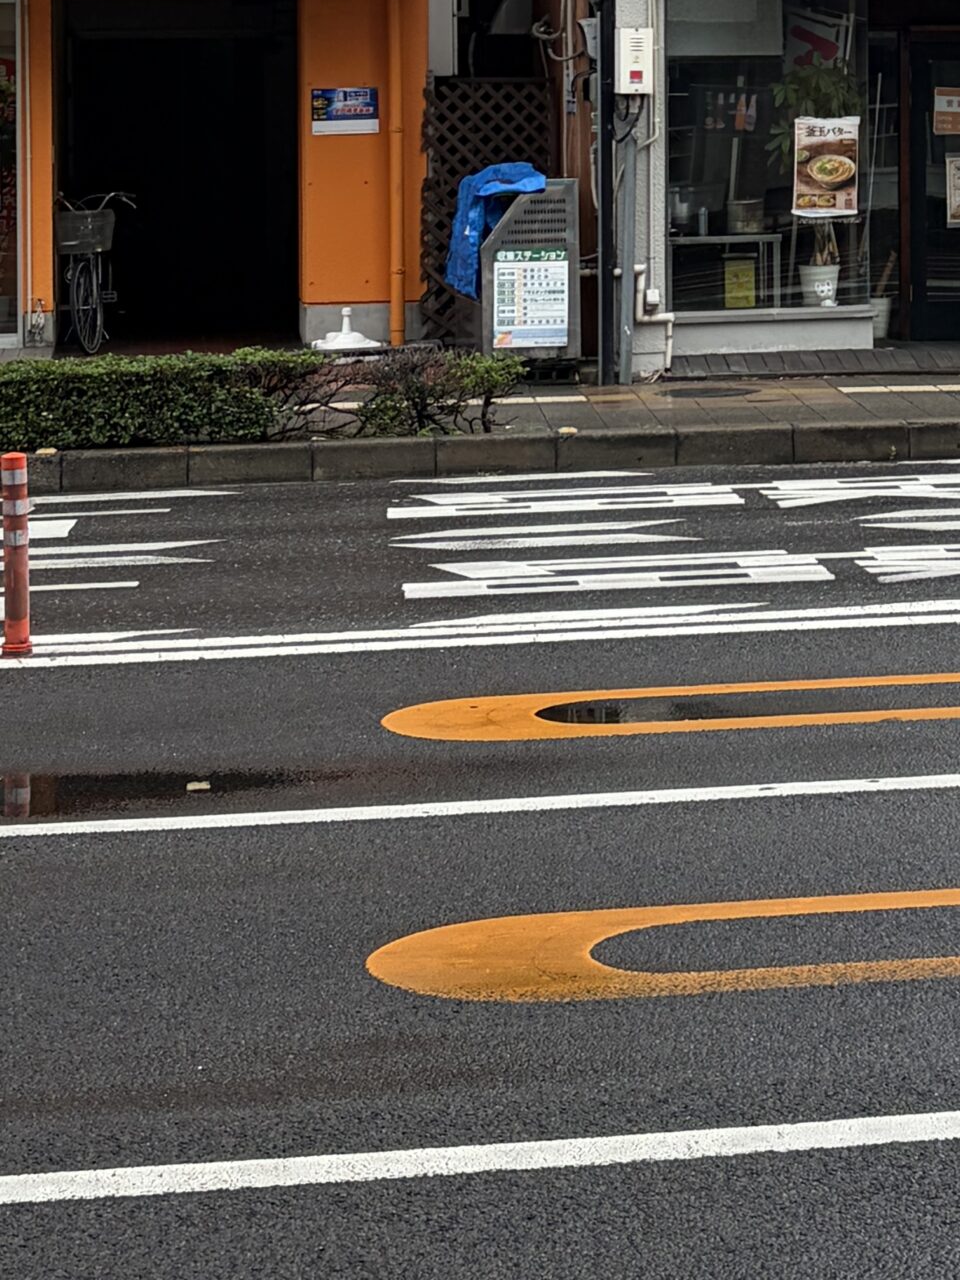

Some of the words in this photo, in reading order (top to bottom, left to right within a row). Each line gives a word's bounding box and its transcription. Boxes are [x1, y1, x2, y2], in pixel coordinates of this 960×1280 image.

[804, 125, 853, 137] 釜玉バター
